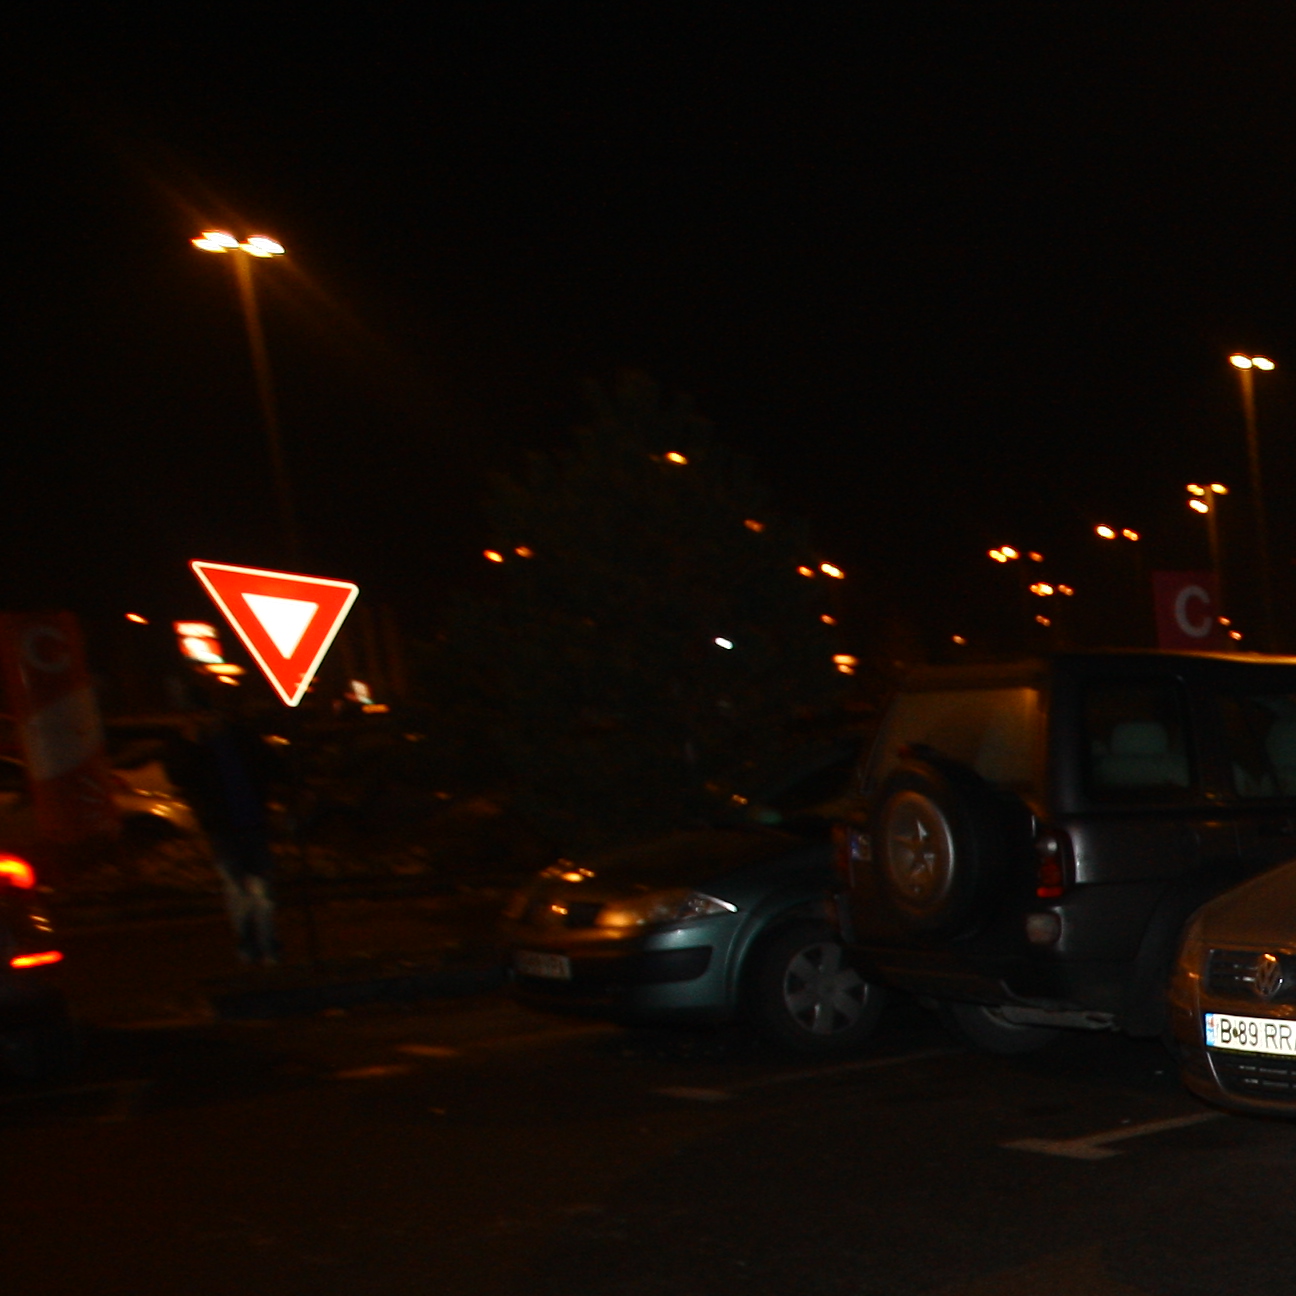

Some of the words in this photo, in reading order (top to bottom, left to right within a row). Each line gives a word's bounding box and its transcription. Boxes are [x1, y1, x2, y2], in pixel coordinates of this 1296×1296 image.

[1174, 584, 1213, 639] C
[1220, 1018, 1232, 1044] B
[1238, 1020, 1258, 1047] 89
